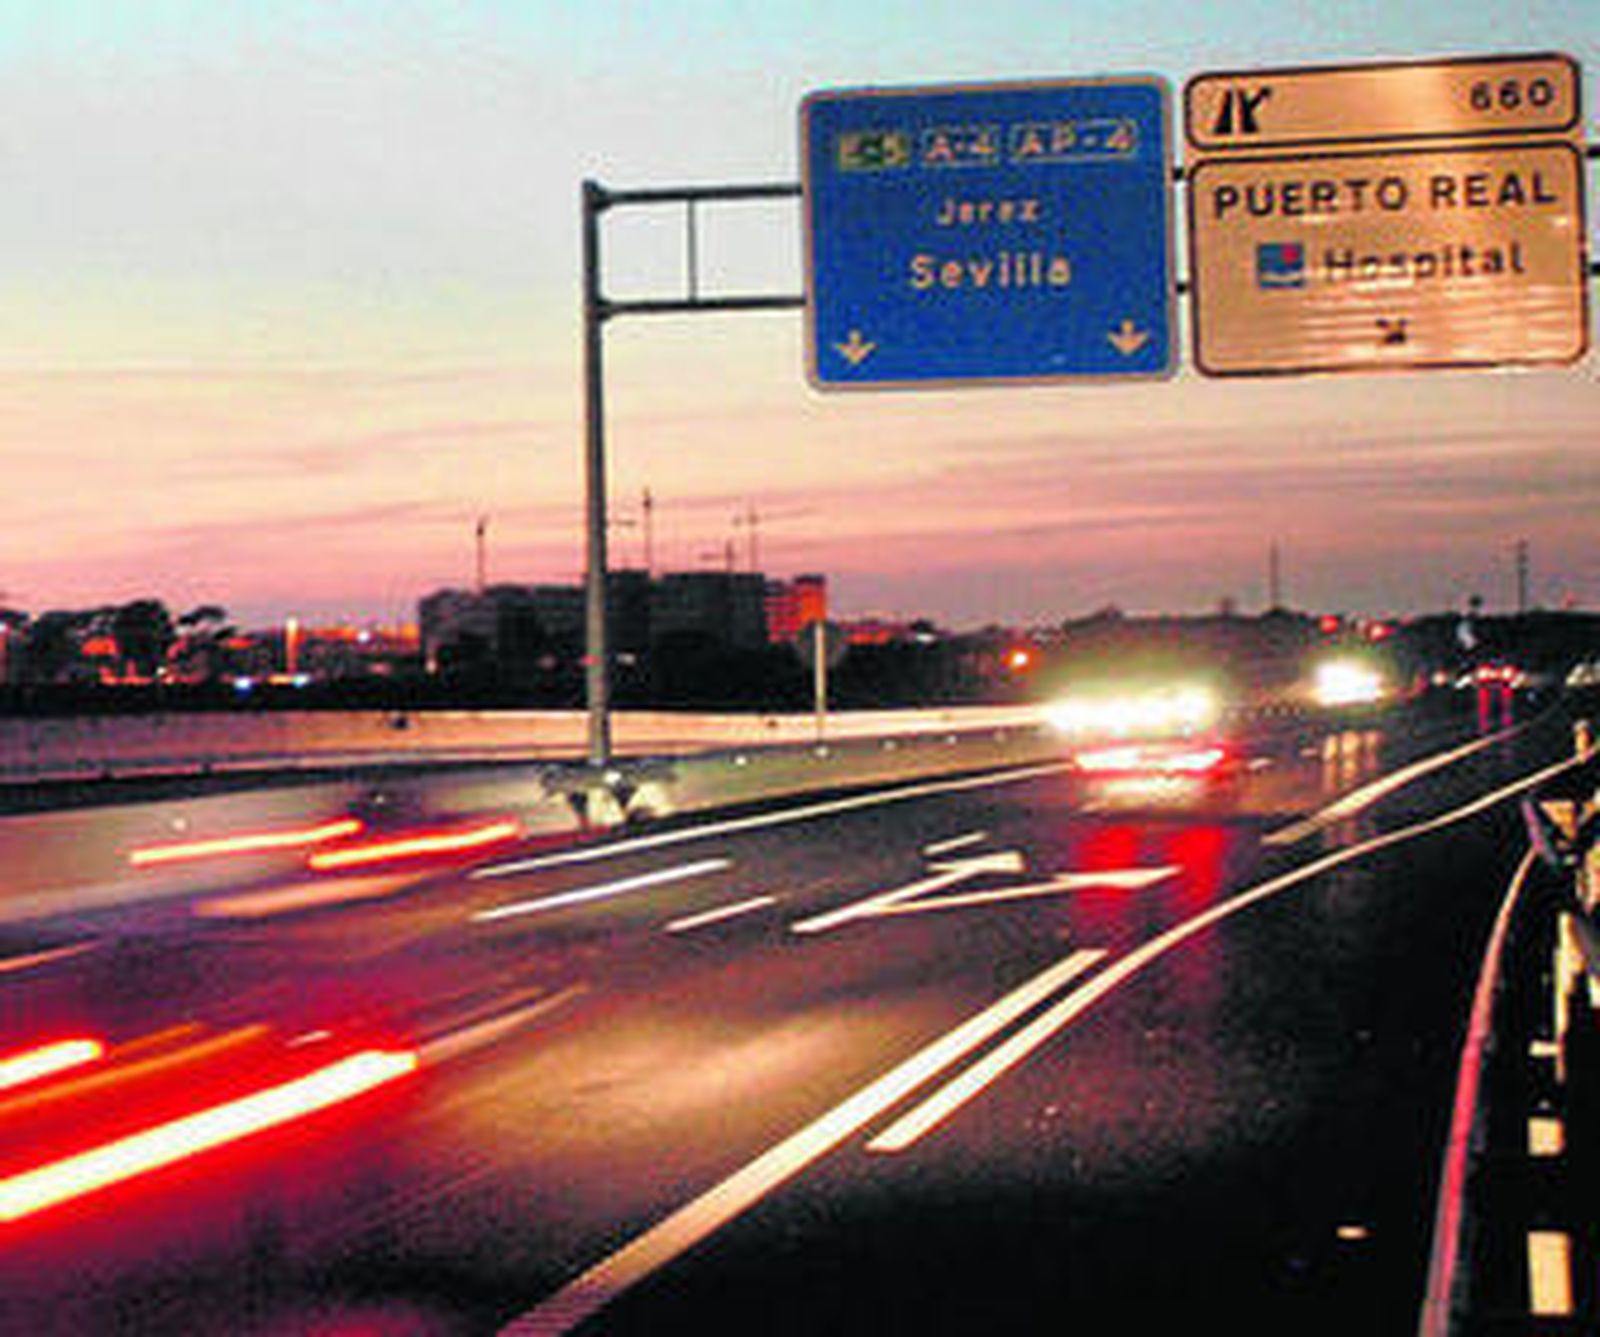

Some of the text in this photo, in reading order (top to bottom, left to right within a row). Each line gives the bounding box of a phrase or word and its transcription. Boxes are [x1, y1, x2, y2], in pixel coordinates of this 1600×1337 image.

[1470, 77, 1555, 112] 660
[926, 127, 994, 161] A-4
[1213, 171, 1558, 218] PUERTO REAL
[909, 251, 1071, 288] Sevilla
[1324, 239, 1525, 283] Hospital
